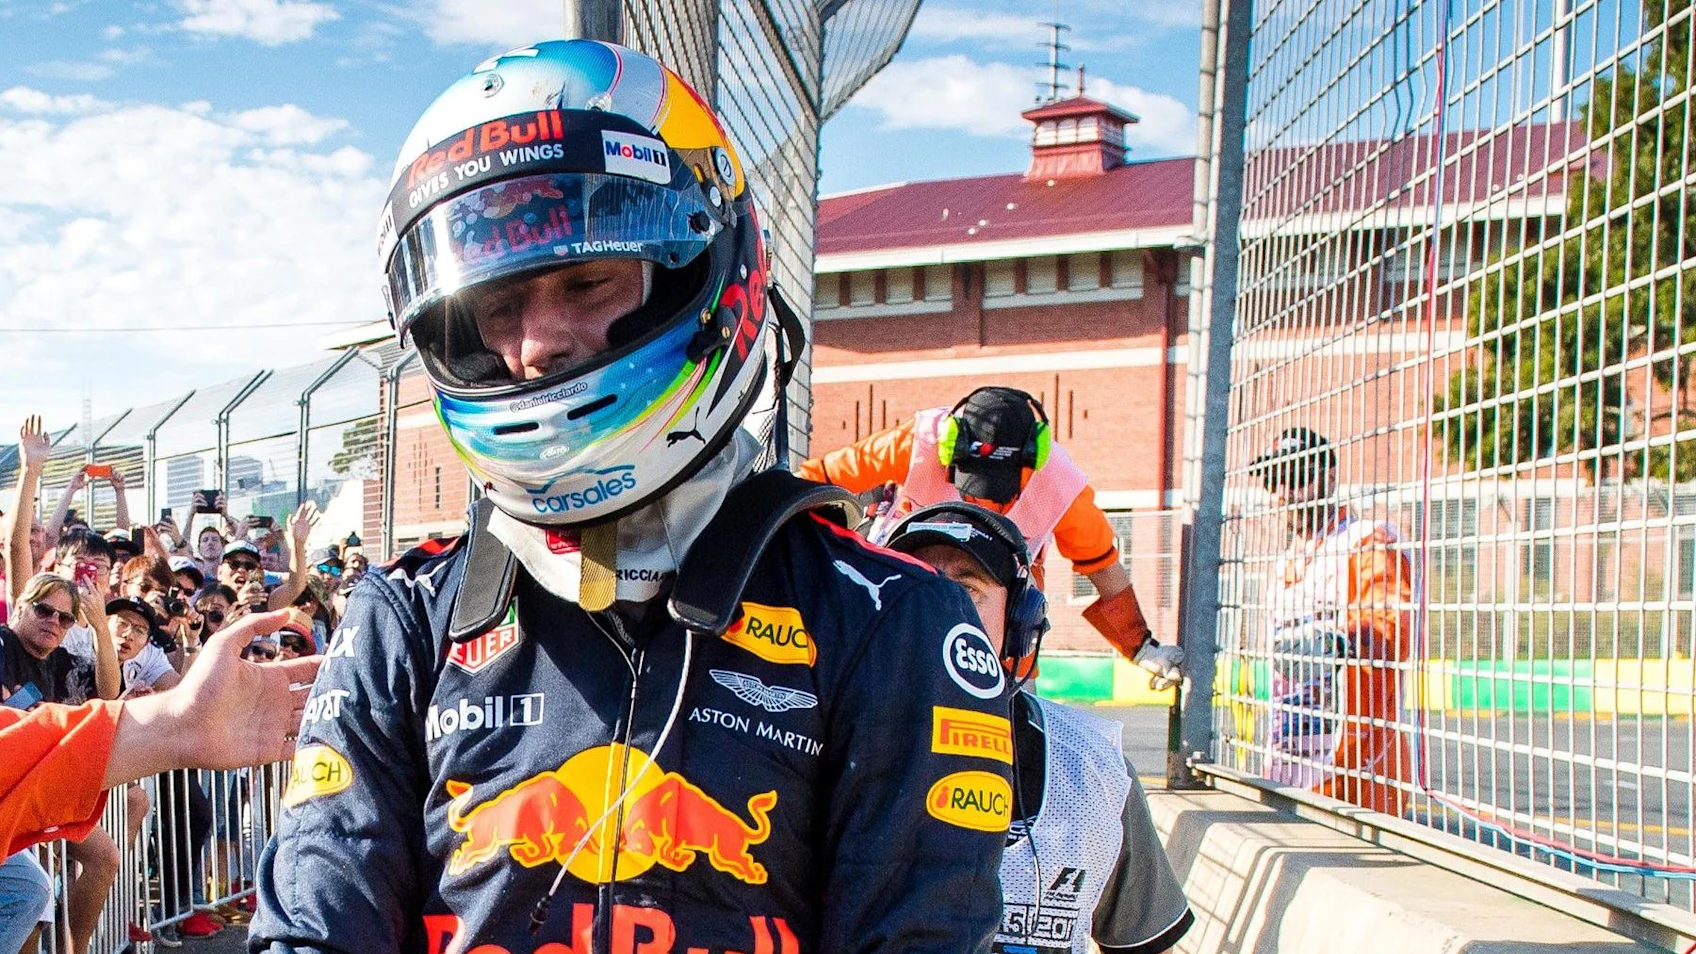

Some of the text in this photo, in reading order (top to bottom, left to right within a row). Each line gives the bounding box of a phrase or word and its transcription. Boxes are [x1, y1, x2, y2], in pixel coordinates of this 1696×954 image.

[480, 110, 564, 153] Bull
[605, 140, 652, 162] Mobil
[409, 143, 564, 209] GIVES YOU WINGS
[510, 381, 588, 413] @danielricciardo
[532, 472, 637, 514] carsales
[616, 568, 667, 582] RICCIA
[450, 629, 515, 669] EUER
[745, 615, 809, 649] RAUC
[425, 696, 504, 741] Mobil
[689, 707, 824, 757] ASTON MARTIN
[939, 718, 1011, 755] PIRELL
